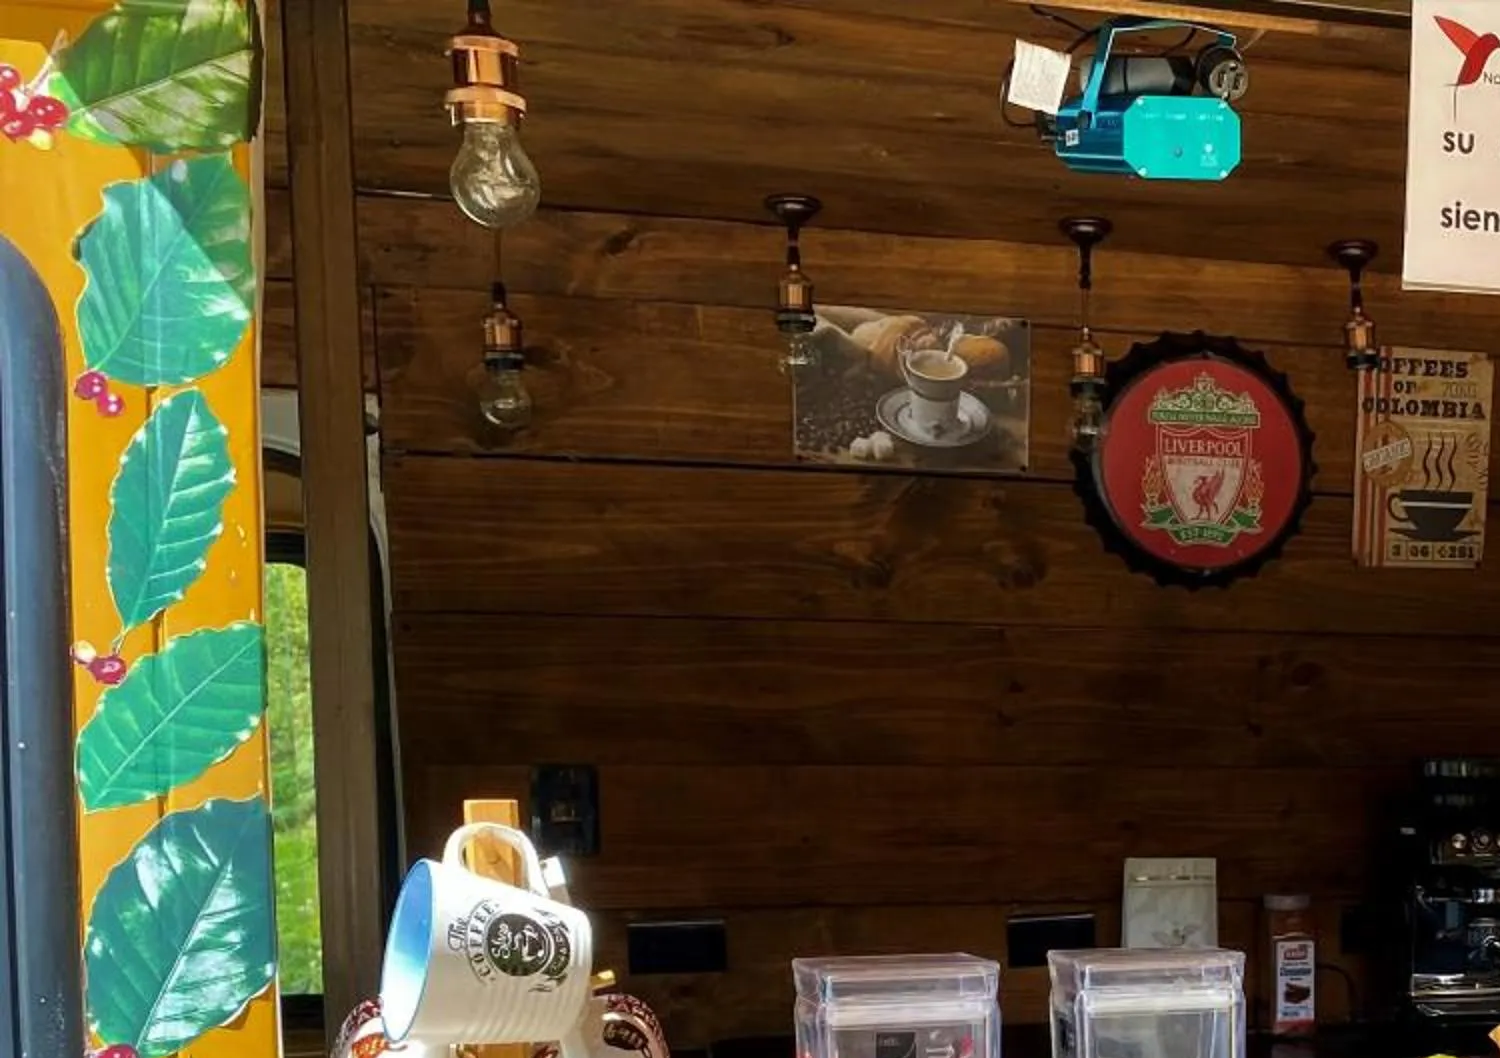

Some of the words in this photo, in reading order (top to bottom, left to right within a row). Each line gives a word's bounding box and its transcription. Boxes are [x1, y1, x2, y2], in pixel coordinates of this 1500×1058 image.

[1442, 130, 1475, 155] su
[1379, 357, 1470, 379] OFFEES
[1393, 380, 1417, 395] OF
[1361, 397, 1486, 419] COLOMBIA
[1163, 437, 1243, 458] LIVERPOOL
